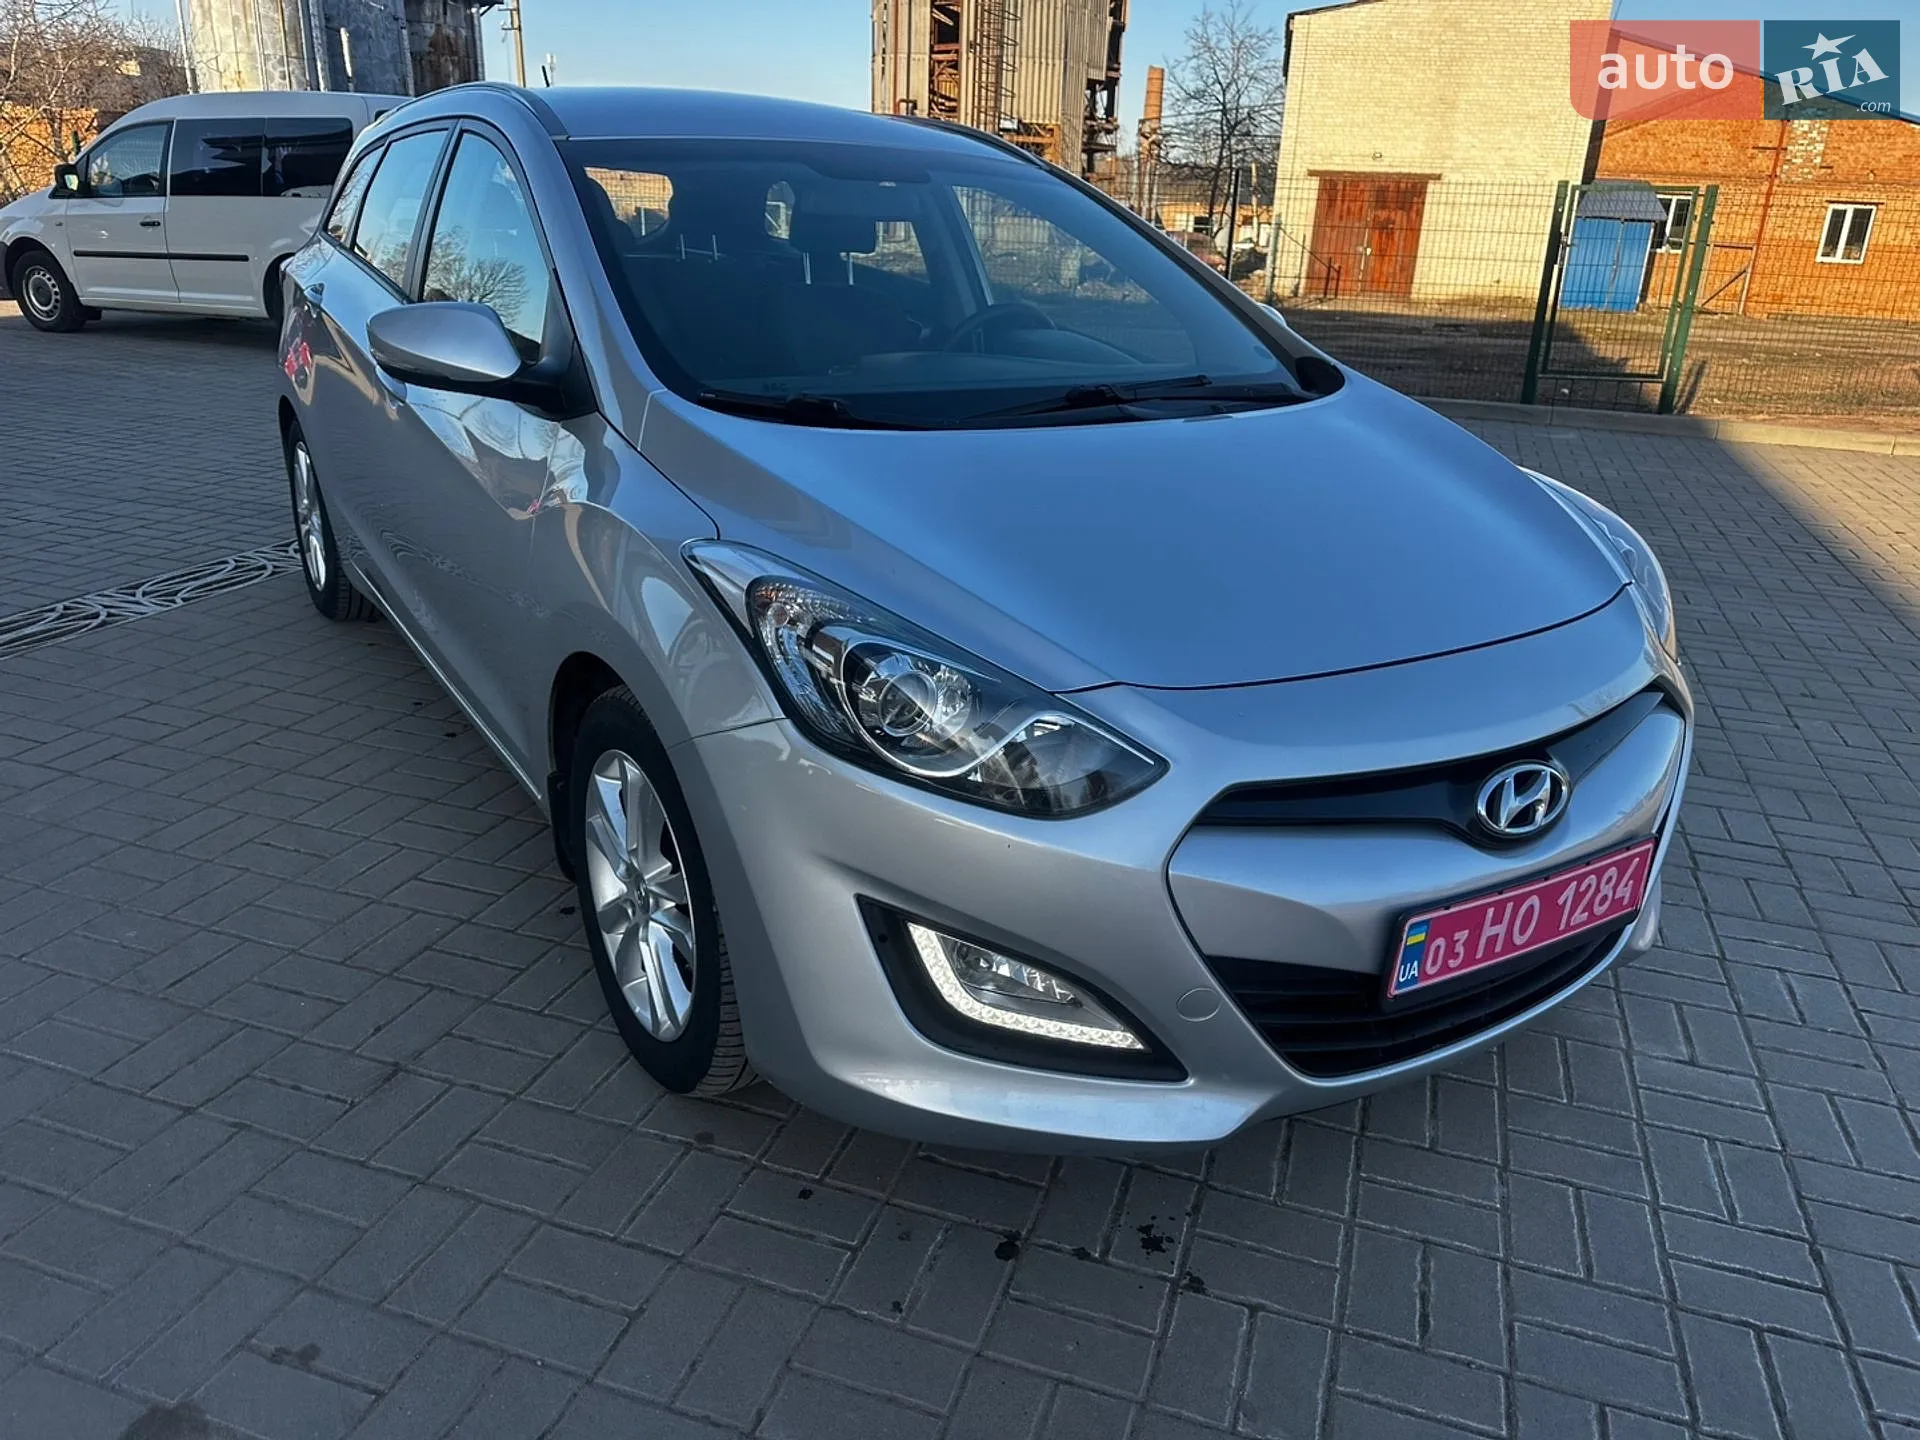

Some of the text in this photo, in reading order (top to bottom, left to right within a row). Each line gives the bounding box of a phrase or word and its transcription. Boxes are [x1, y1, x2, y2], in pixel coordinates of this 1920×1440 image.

[1424, 857, 1641, 976] 03 HO 1284
[1398, 959, 1420, 983] UA
